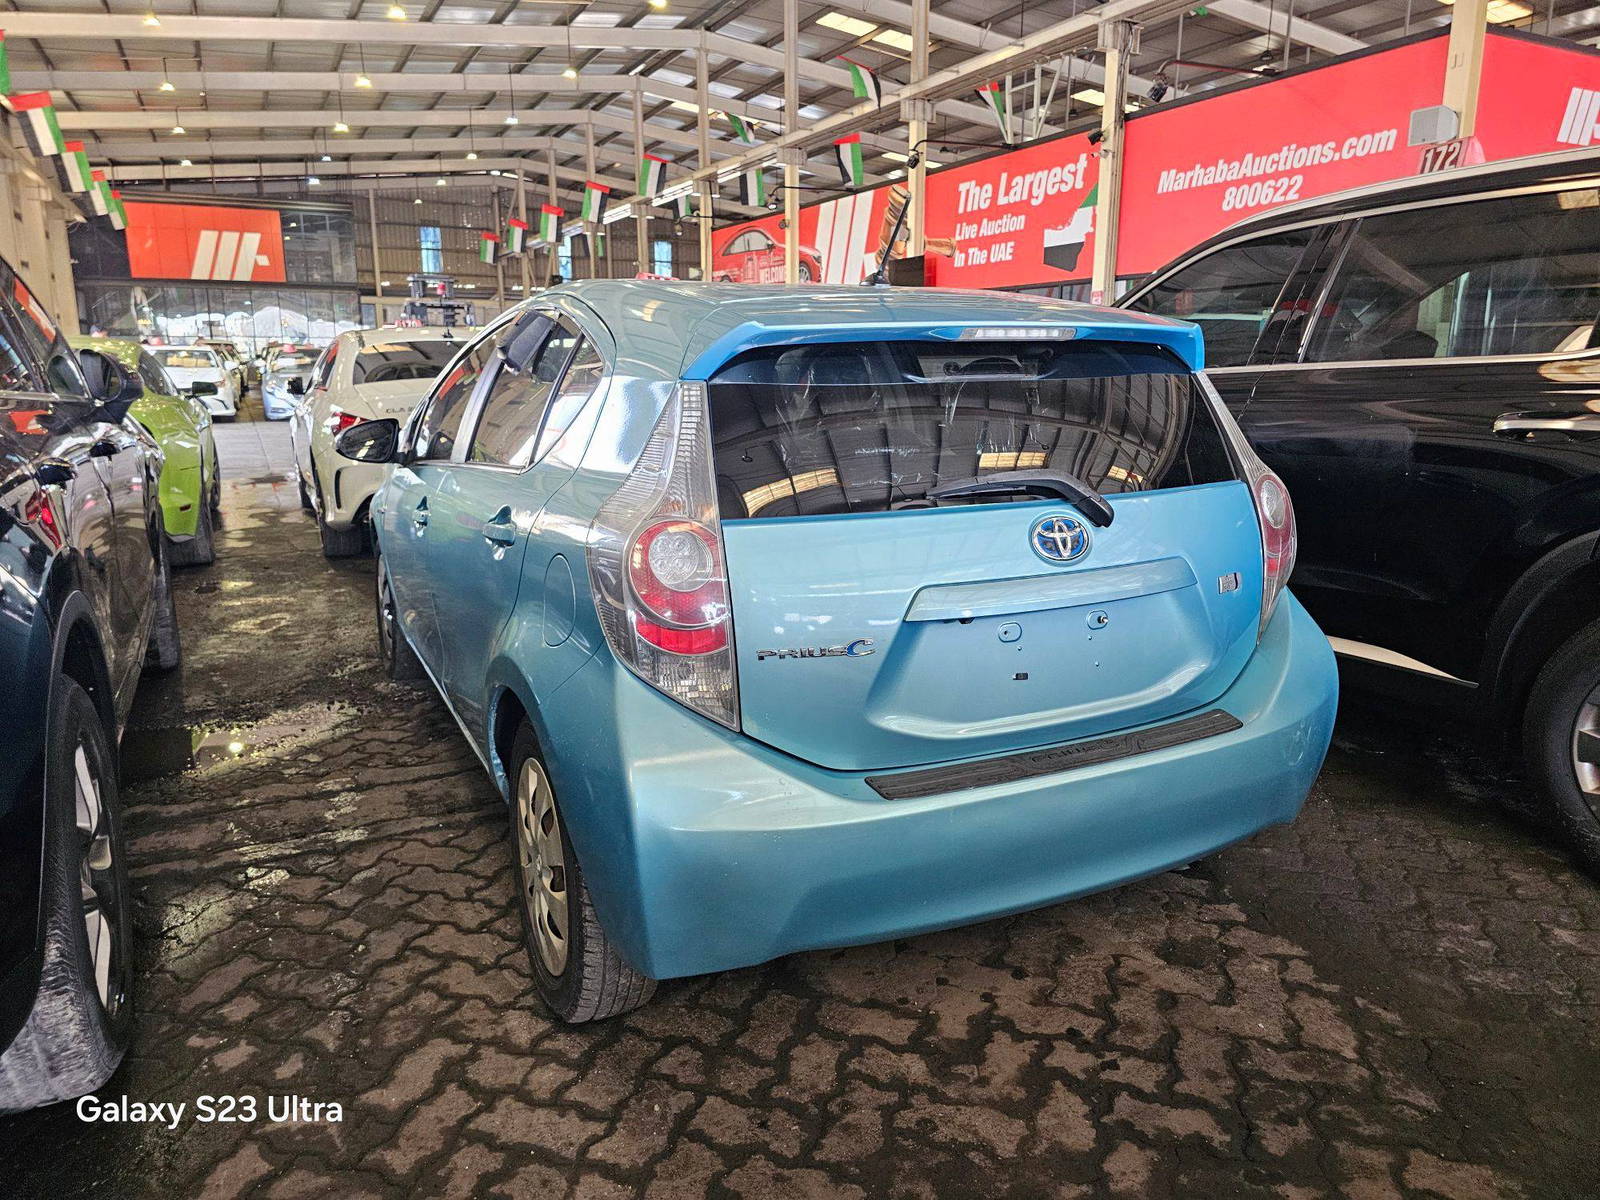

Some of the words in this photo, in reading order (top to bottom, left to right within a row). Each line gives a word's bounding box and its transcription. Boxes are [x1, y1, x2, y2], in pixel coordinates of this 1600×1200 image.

[1156, 128, 1398, 194] MarhabaAuctions.com
[1424, 141, 1461, 173] 172
[958, 180, 993, 214] The
[997, 153, 1088, 206] Largest
[1221, 174, 1303, 212] 800622
[955, 223, 977, 241] Live
[979, 214, 1026, 238] Auction
[954, 250, 966, 268] In
[967, 247, 988, 265] The
[990, 242, 1015, 263] UAE
